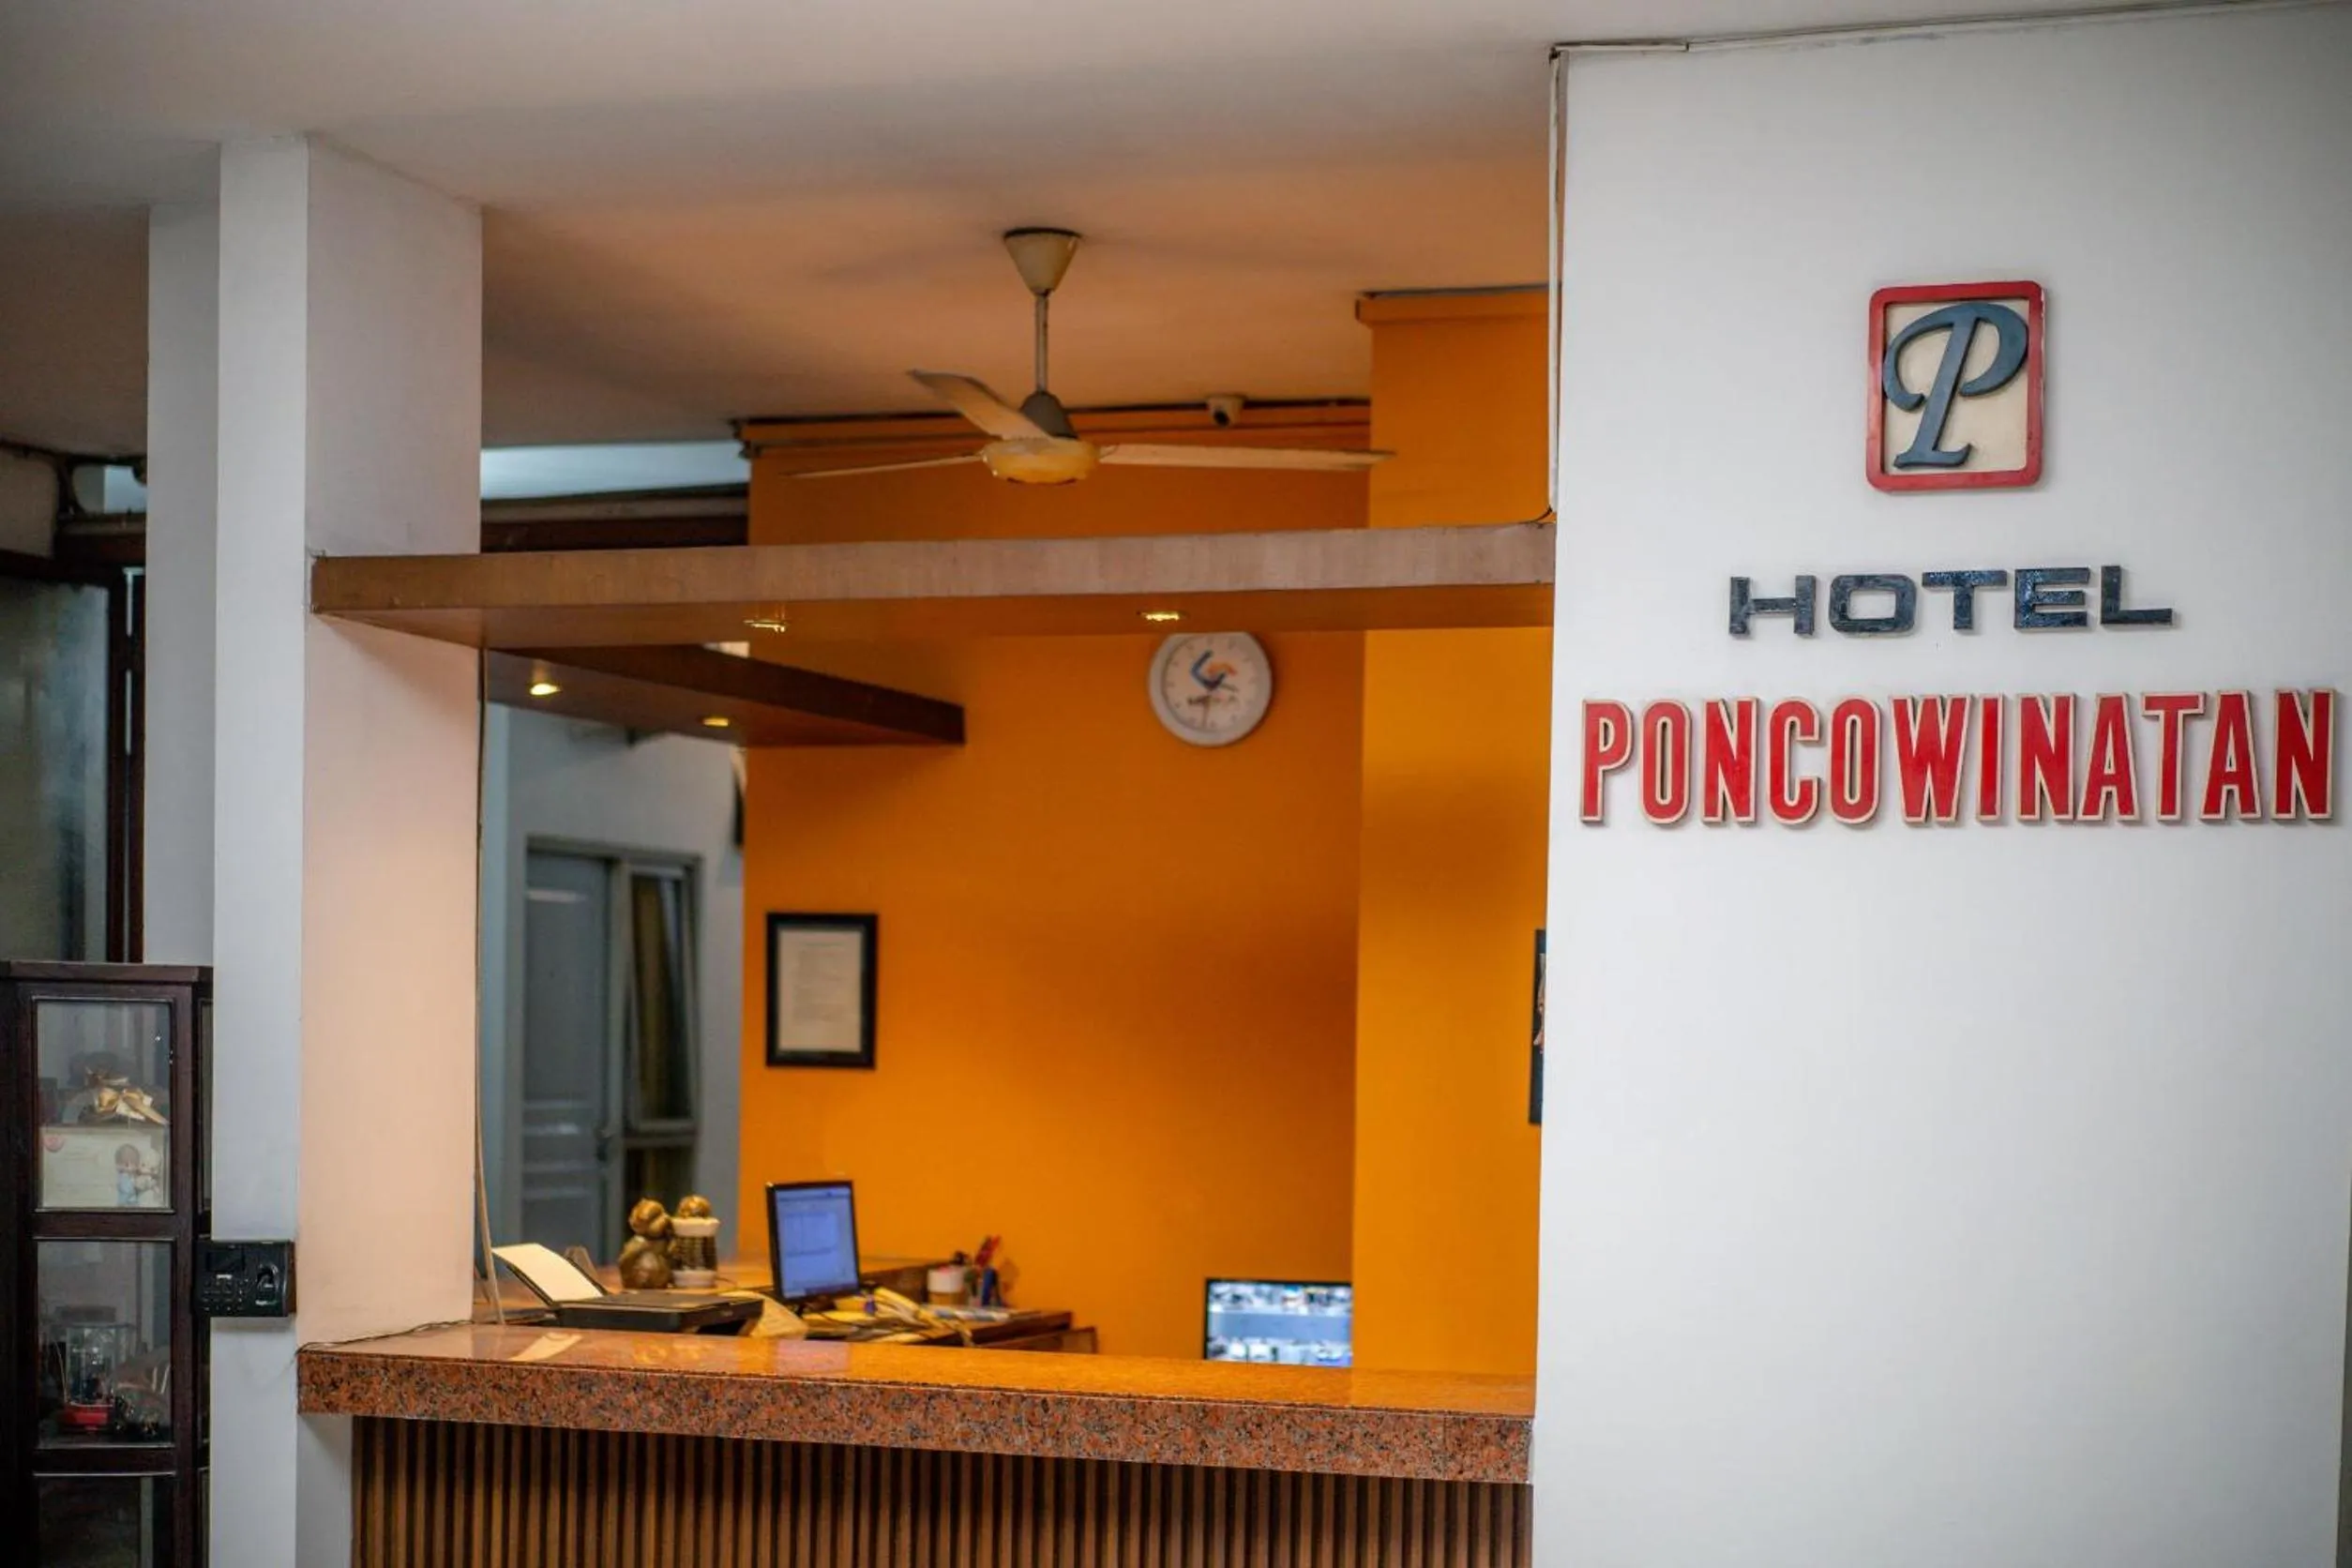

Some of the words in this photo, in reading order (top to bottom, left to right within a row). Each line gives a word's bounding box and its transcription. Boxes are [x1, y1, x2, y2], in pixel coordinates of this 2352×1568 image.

[1881, 301, 2029, 469] P
[1728, 564, 2174, 635] HOTEL
[1580, 687, 2335, 823] PONCOWINATAN
